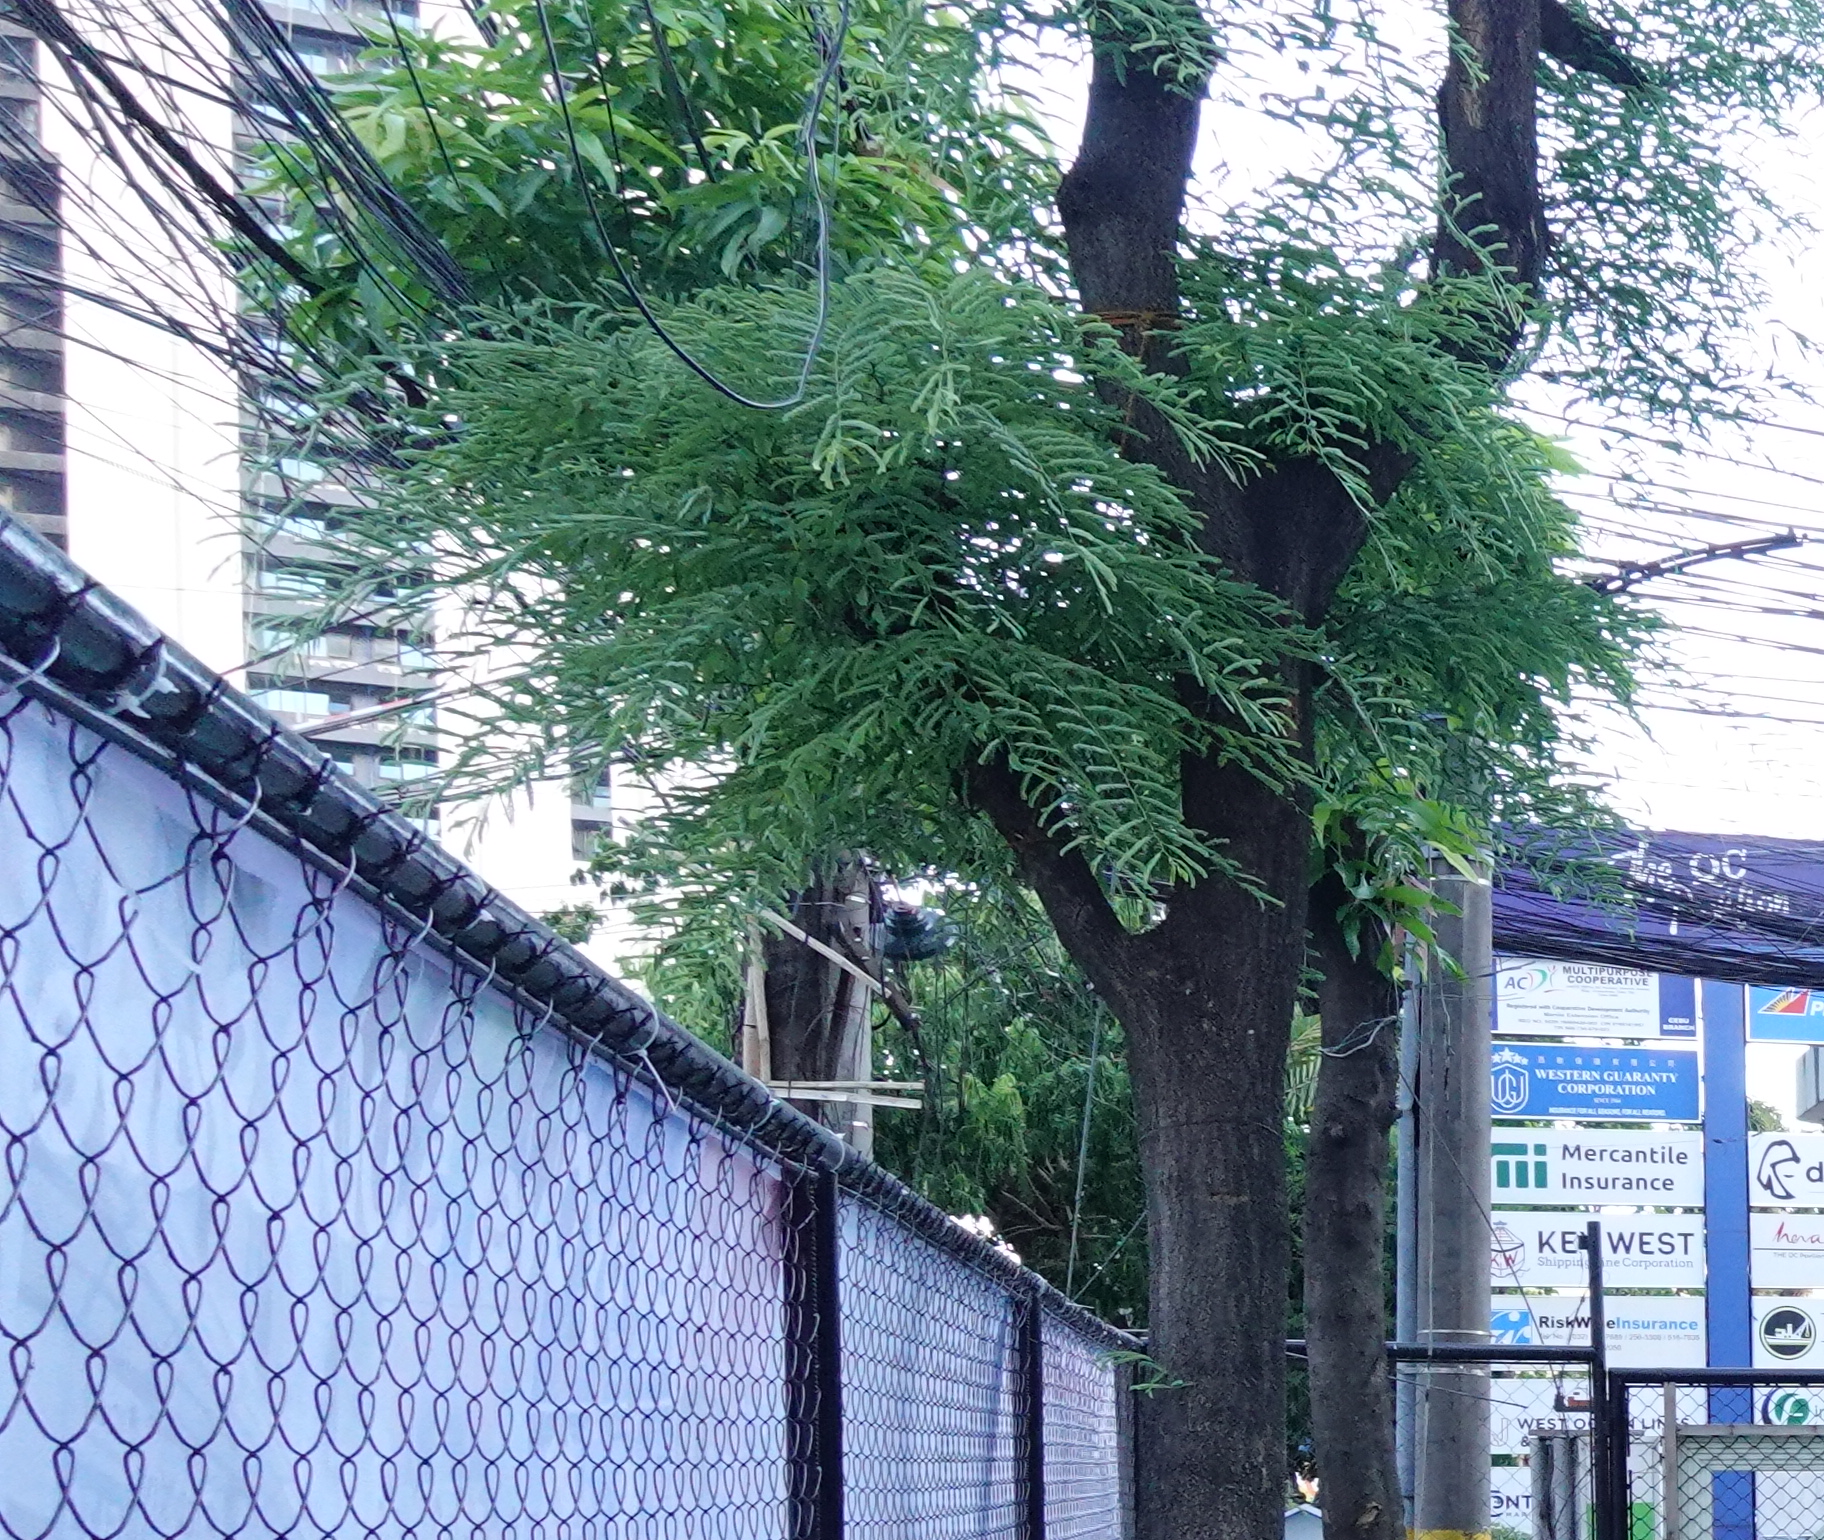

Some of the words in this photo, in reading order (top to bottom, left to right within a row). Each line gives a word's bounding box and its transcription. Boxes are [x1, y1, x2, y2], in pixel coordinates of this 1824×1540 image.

[1561, 965, 1654, 978] MULTIPURPOSE
[1567, 974, 1650, 986] COOPERATIVE
[1535, 1068, 1600, 1083] WESTERN
[1603, 1070, 1679, 1084] GUARANTY
[1557, 1083, 1656, 1096] CORPORATION
[1561, 1144, 1689, 1165] Mercantile
[1562, 1172, 1675, 1191] Insurance
[1537, 1231, 1588, 1254] KE
[1606, 1232, 1695, 1256] WEST
[1622, 1257, 1694, 1270] Corporation
[1539, 1316, 1699, 1331] RiskWeInsurance
[1517, 1417, 1567, 1431] WEST
